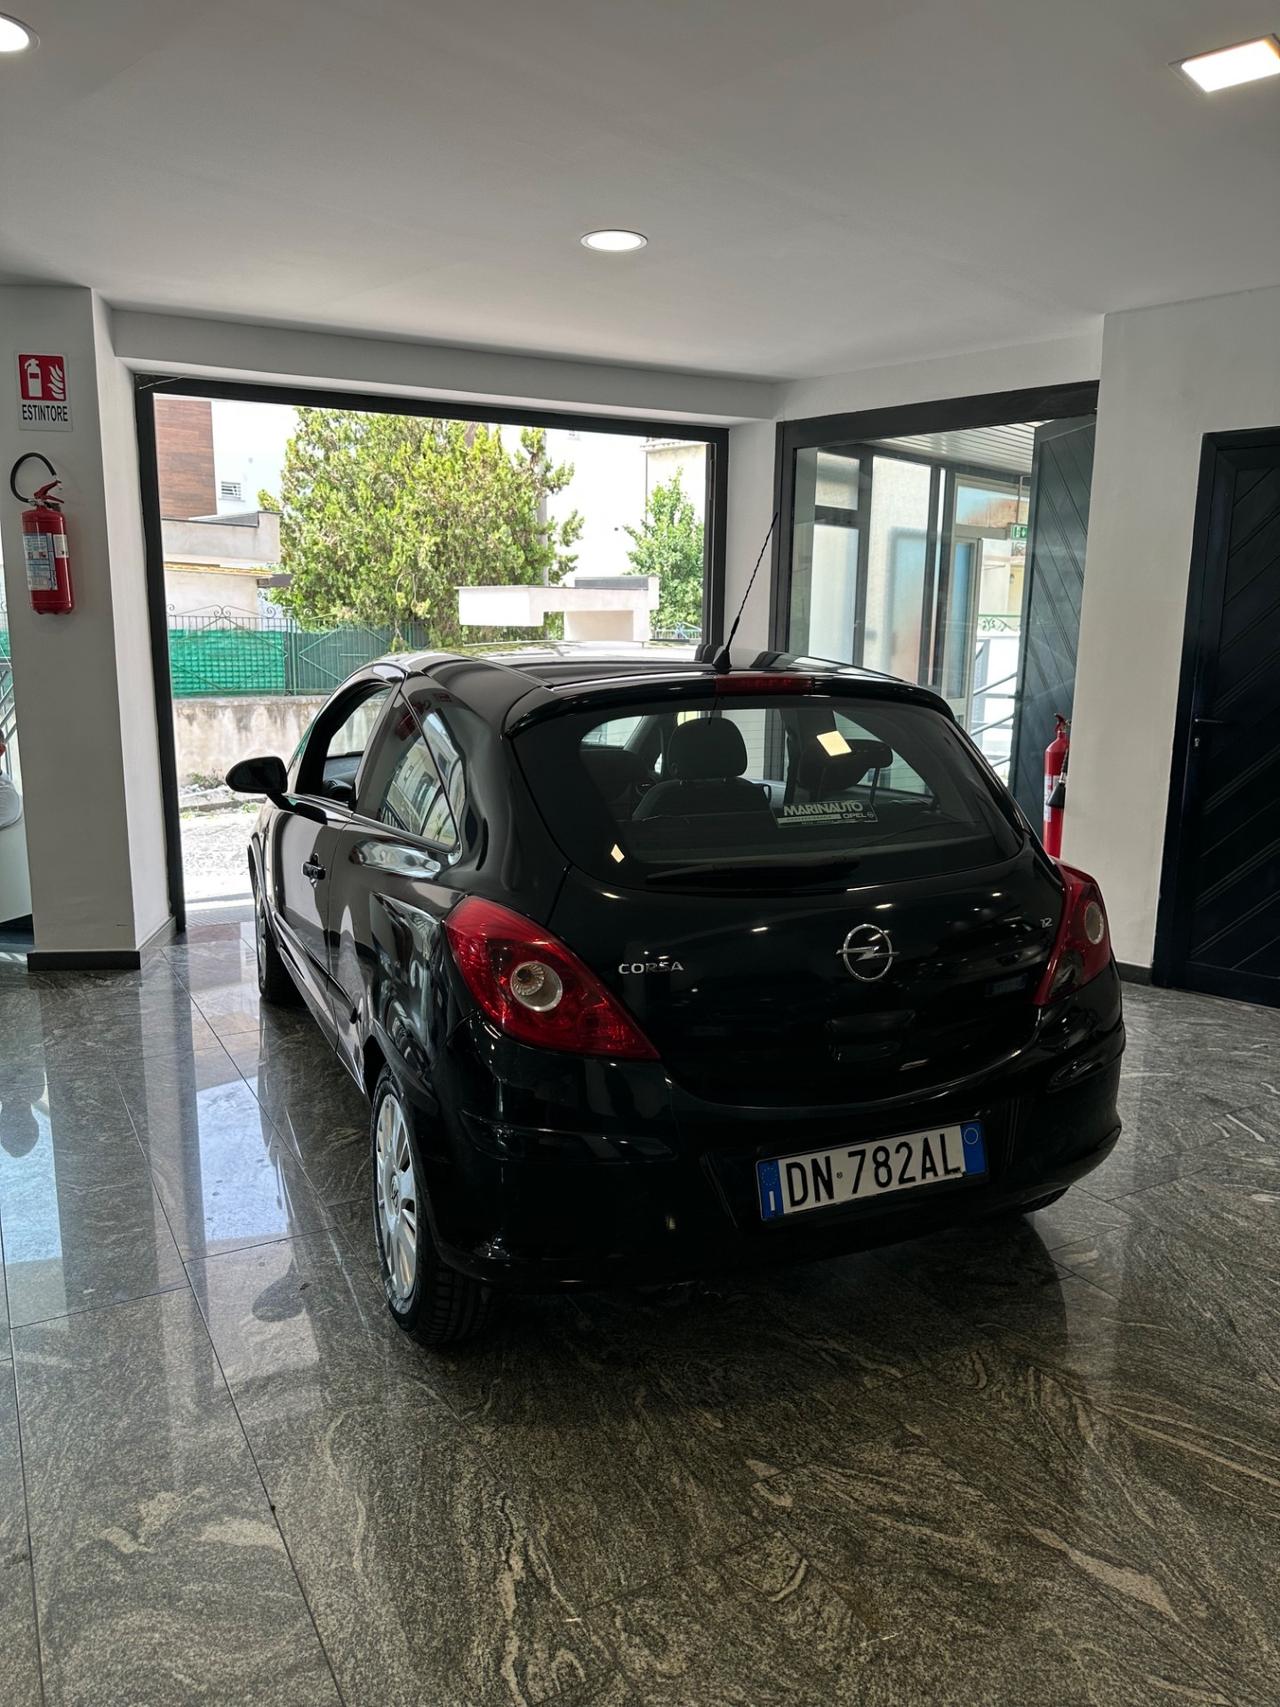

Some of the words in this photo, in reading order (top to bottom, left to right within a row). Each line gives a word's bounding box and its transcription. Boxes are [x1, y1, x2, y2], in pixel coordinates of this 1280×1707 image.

[22, 404, 68, 422] ESTINTORE
[784, 800, 864, 816] MARINAUTO
[618, 961, 684, 975] CORSA
